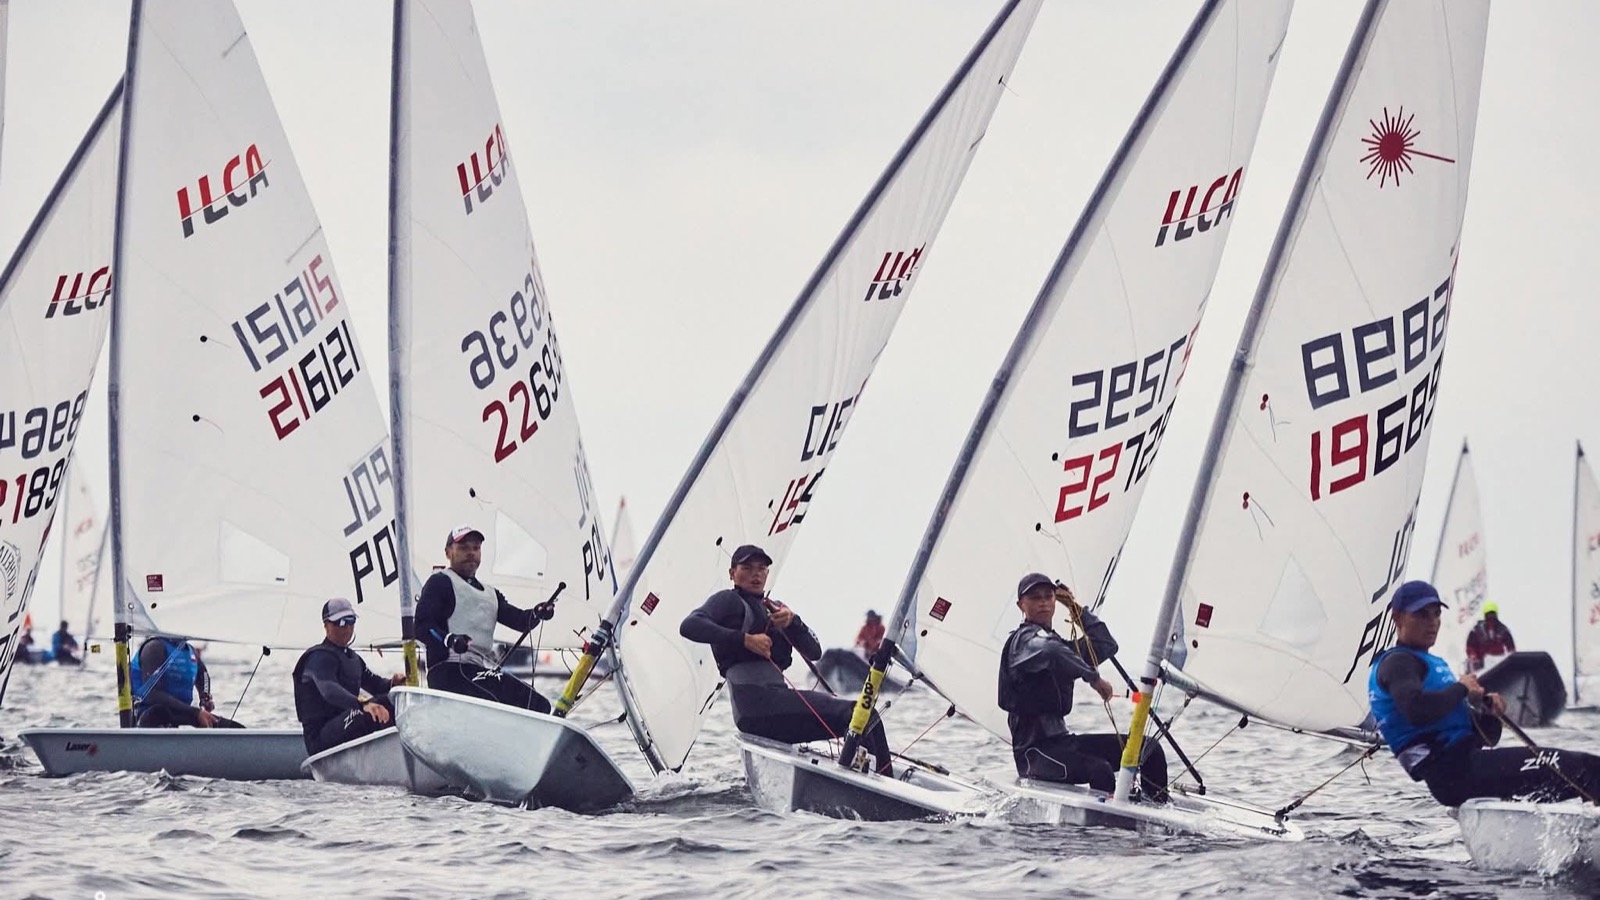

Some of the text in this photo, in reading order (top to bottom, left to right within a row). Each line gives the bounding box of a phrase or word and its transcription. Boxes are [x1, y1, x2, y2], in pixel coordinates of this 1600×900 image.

[177, 143, 272, 239] ILCA
[457, 122, 510, 216] ILCA
[1154, 166, 1243, 248] ILCA
[259, 319, 361, 441] 216121
[65, 741, 90, 752] Laser
